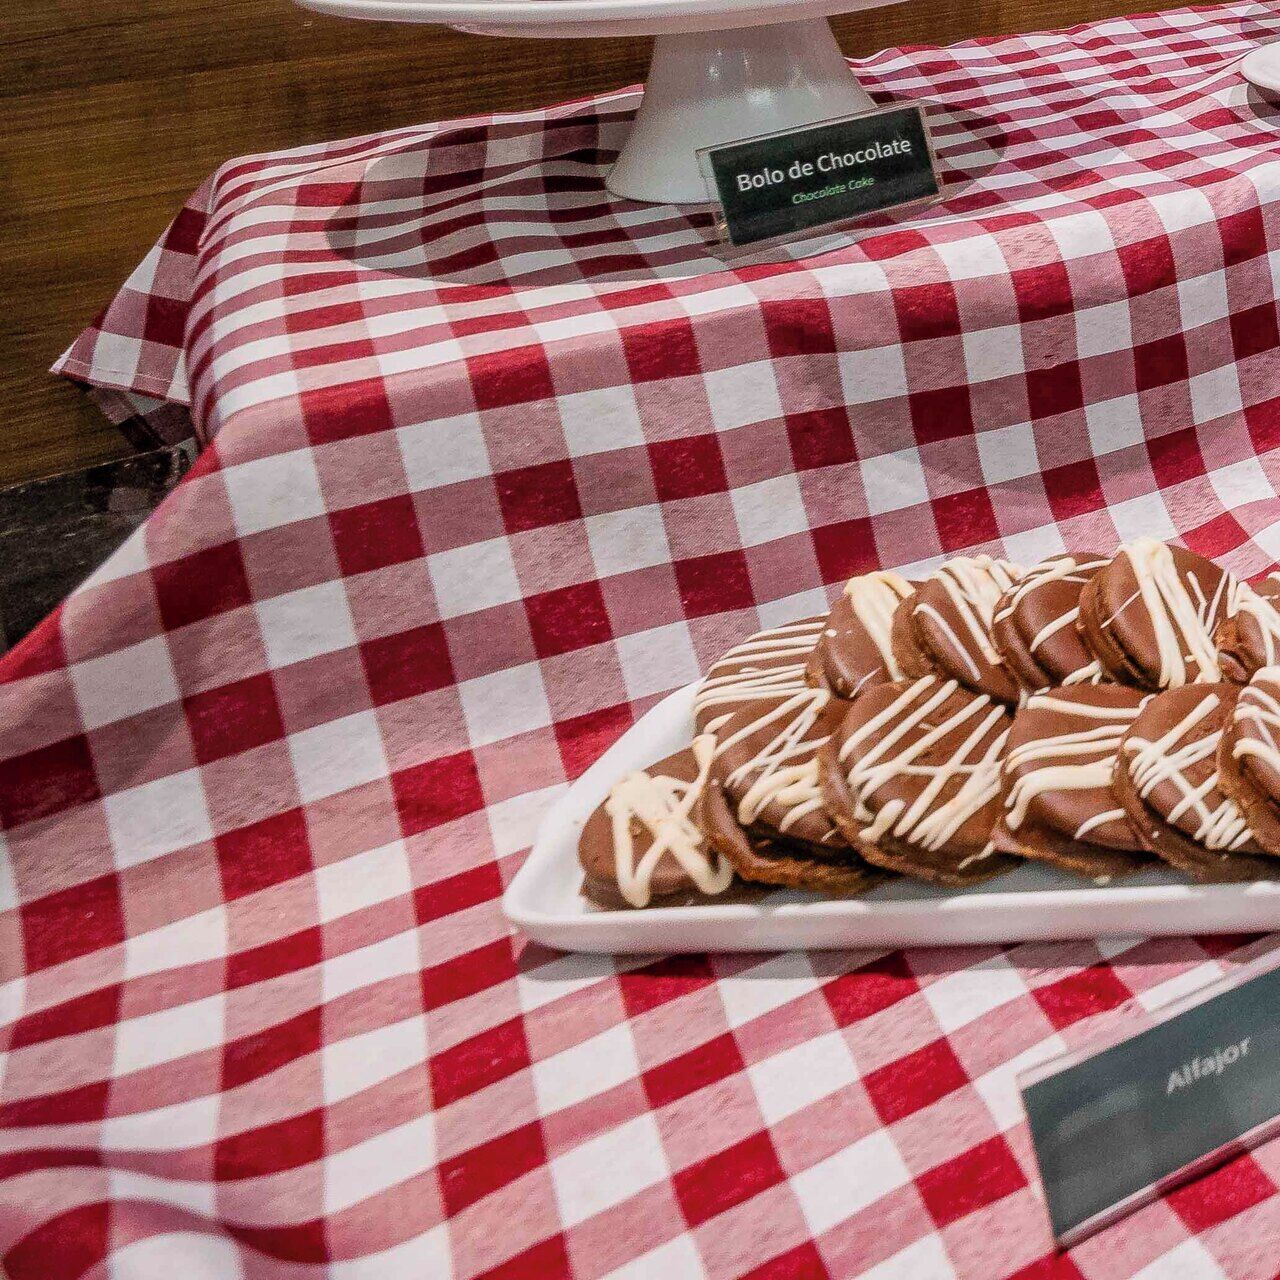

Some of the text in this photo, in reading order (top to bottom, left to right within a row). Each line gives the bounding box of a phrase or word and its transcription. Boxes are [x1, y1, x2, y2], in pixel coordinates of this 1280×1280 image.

[735, 138, 912, 192] Bolo de Chocolate
[792, 177, 875, 204] Chocolate Cake
[1165, 1036, 1251, 1095] Alfajor
